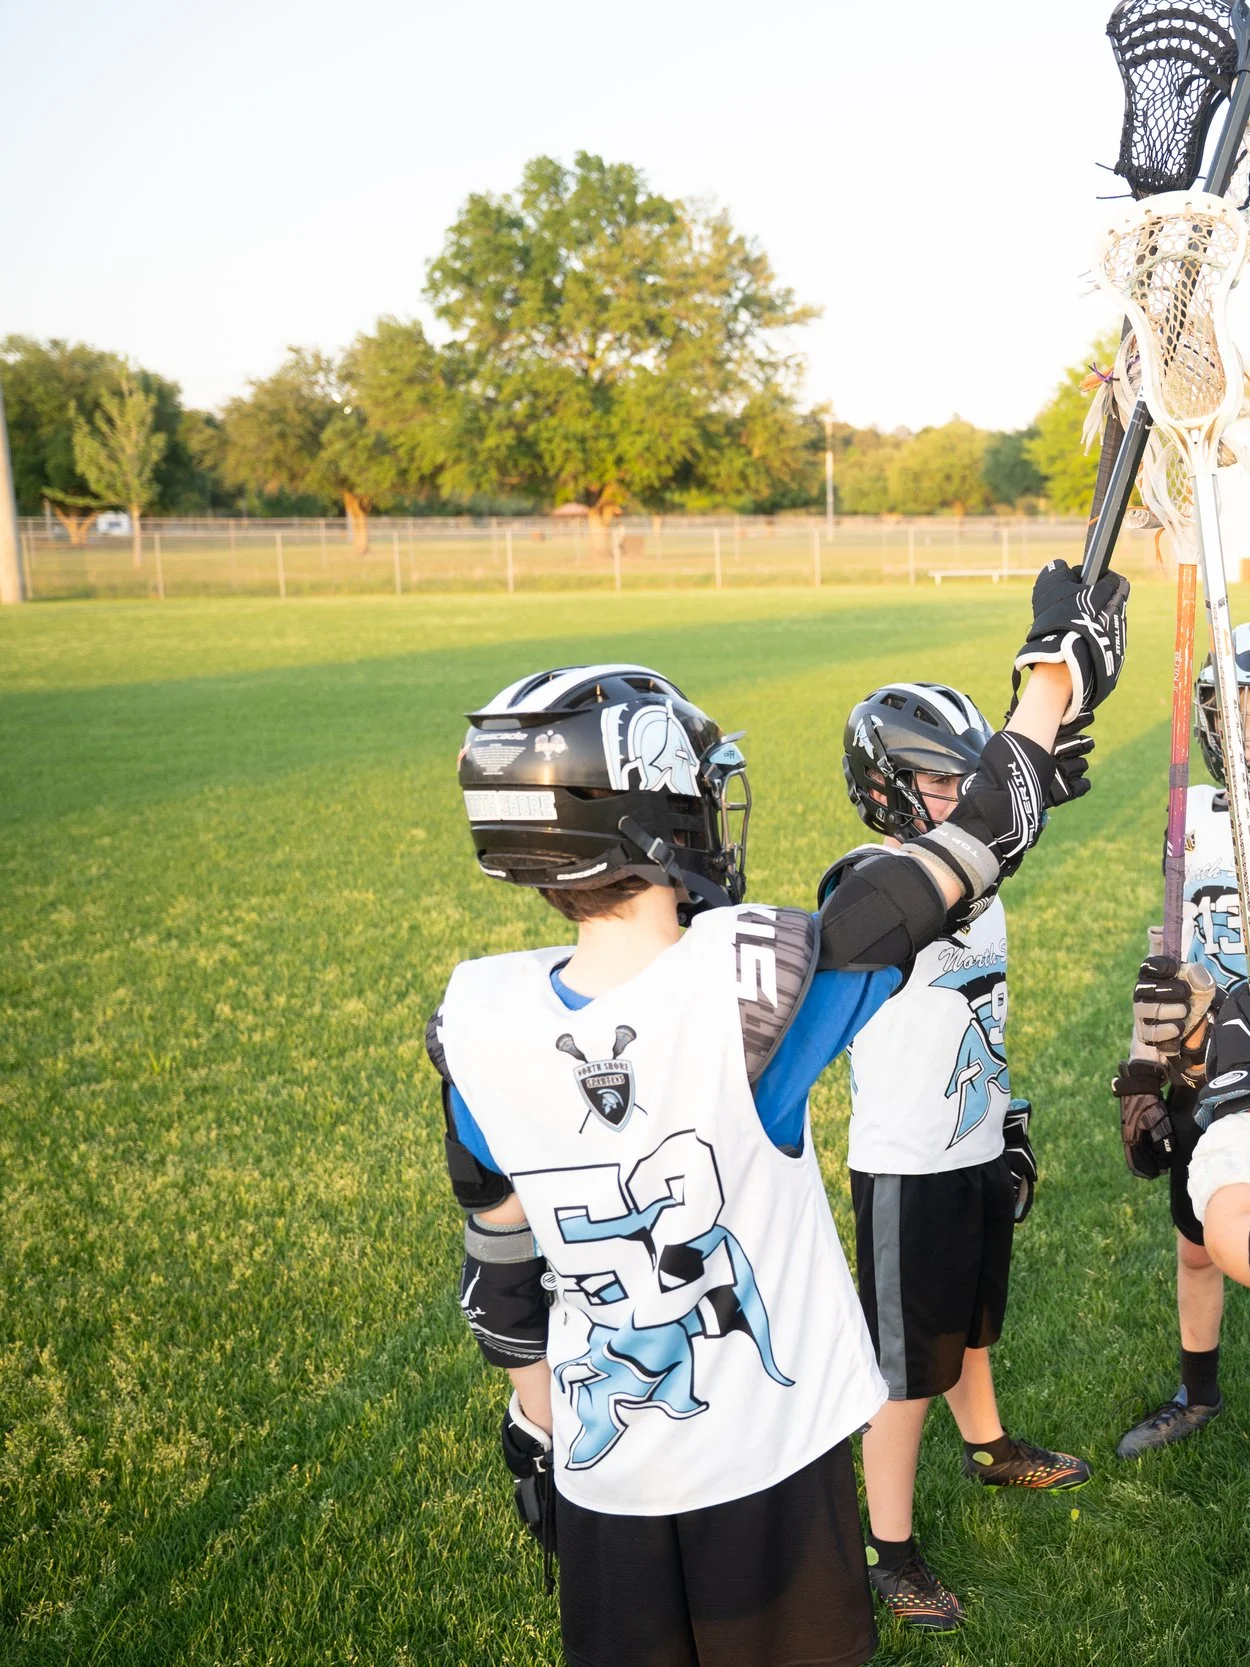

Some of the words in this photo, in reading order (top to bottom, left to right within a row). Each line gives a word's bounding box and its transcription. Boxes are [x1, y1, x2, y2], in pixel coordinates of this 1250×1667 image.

[1071, 611, 1115, 677] STX
[1113, 614, 1121, 656] STALLION
[951, 837, 978, 859] TOP
[938, 943, 997, 973] North
[604, 1062, 628, 1071] SHORE
